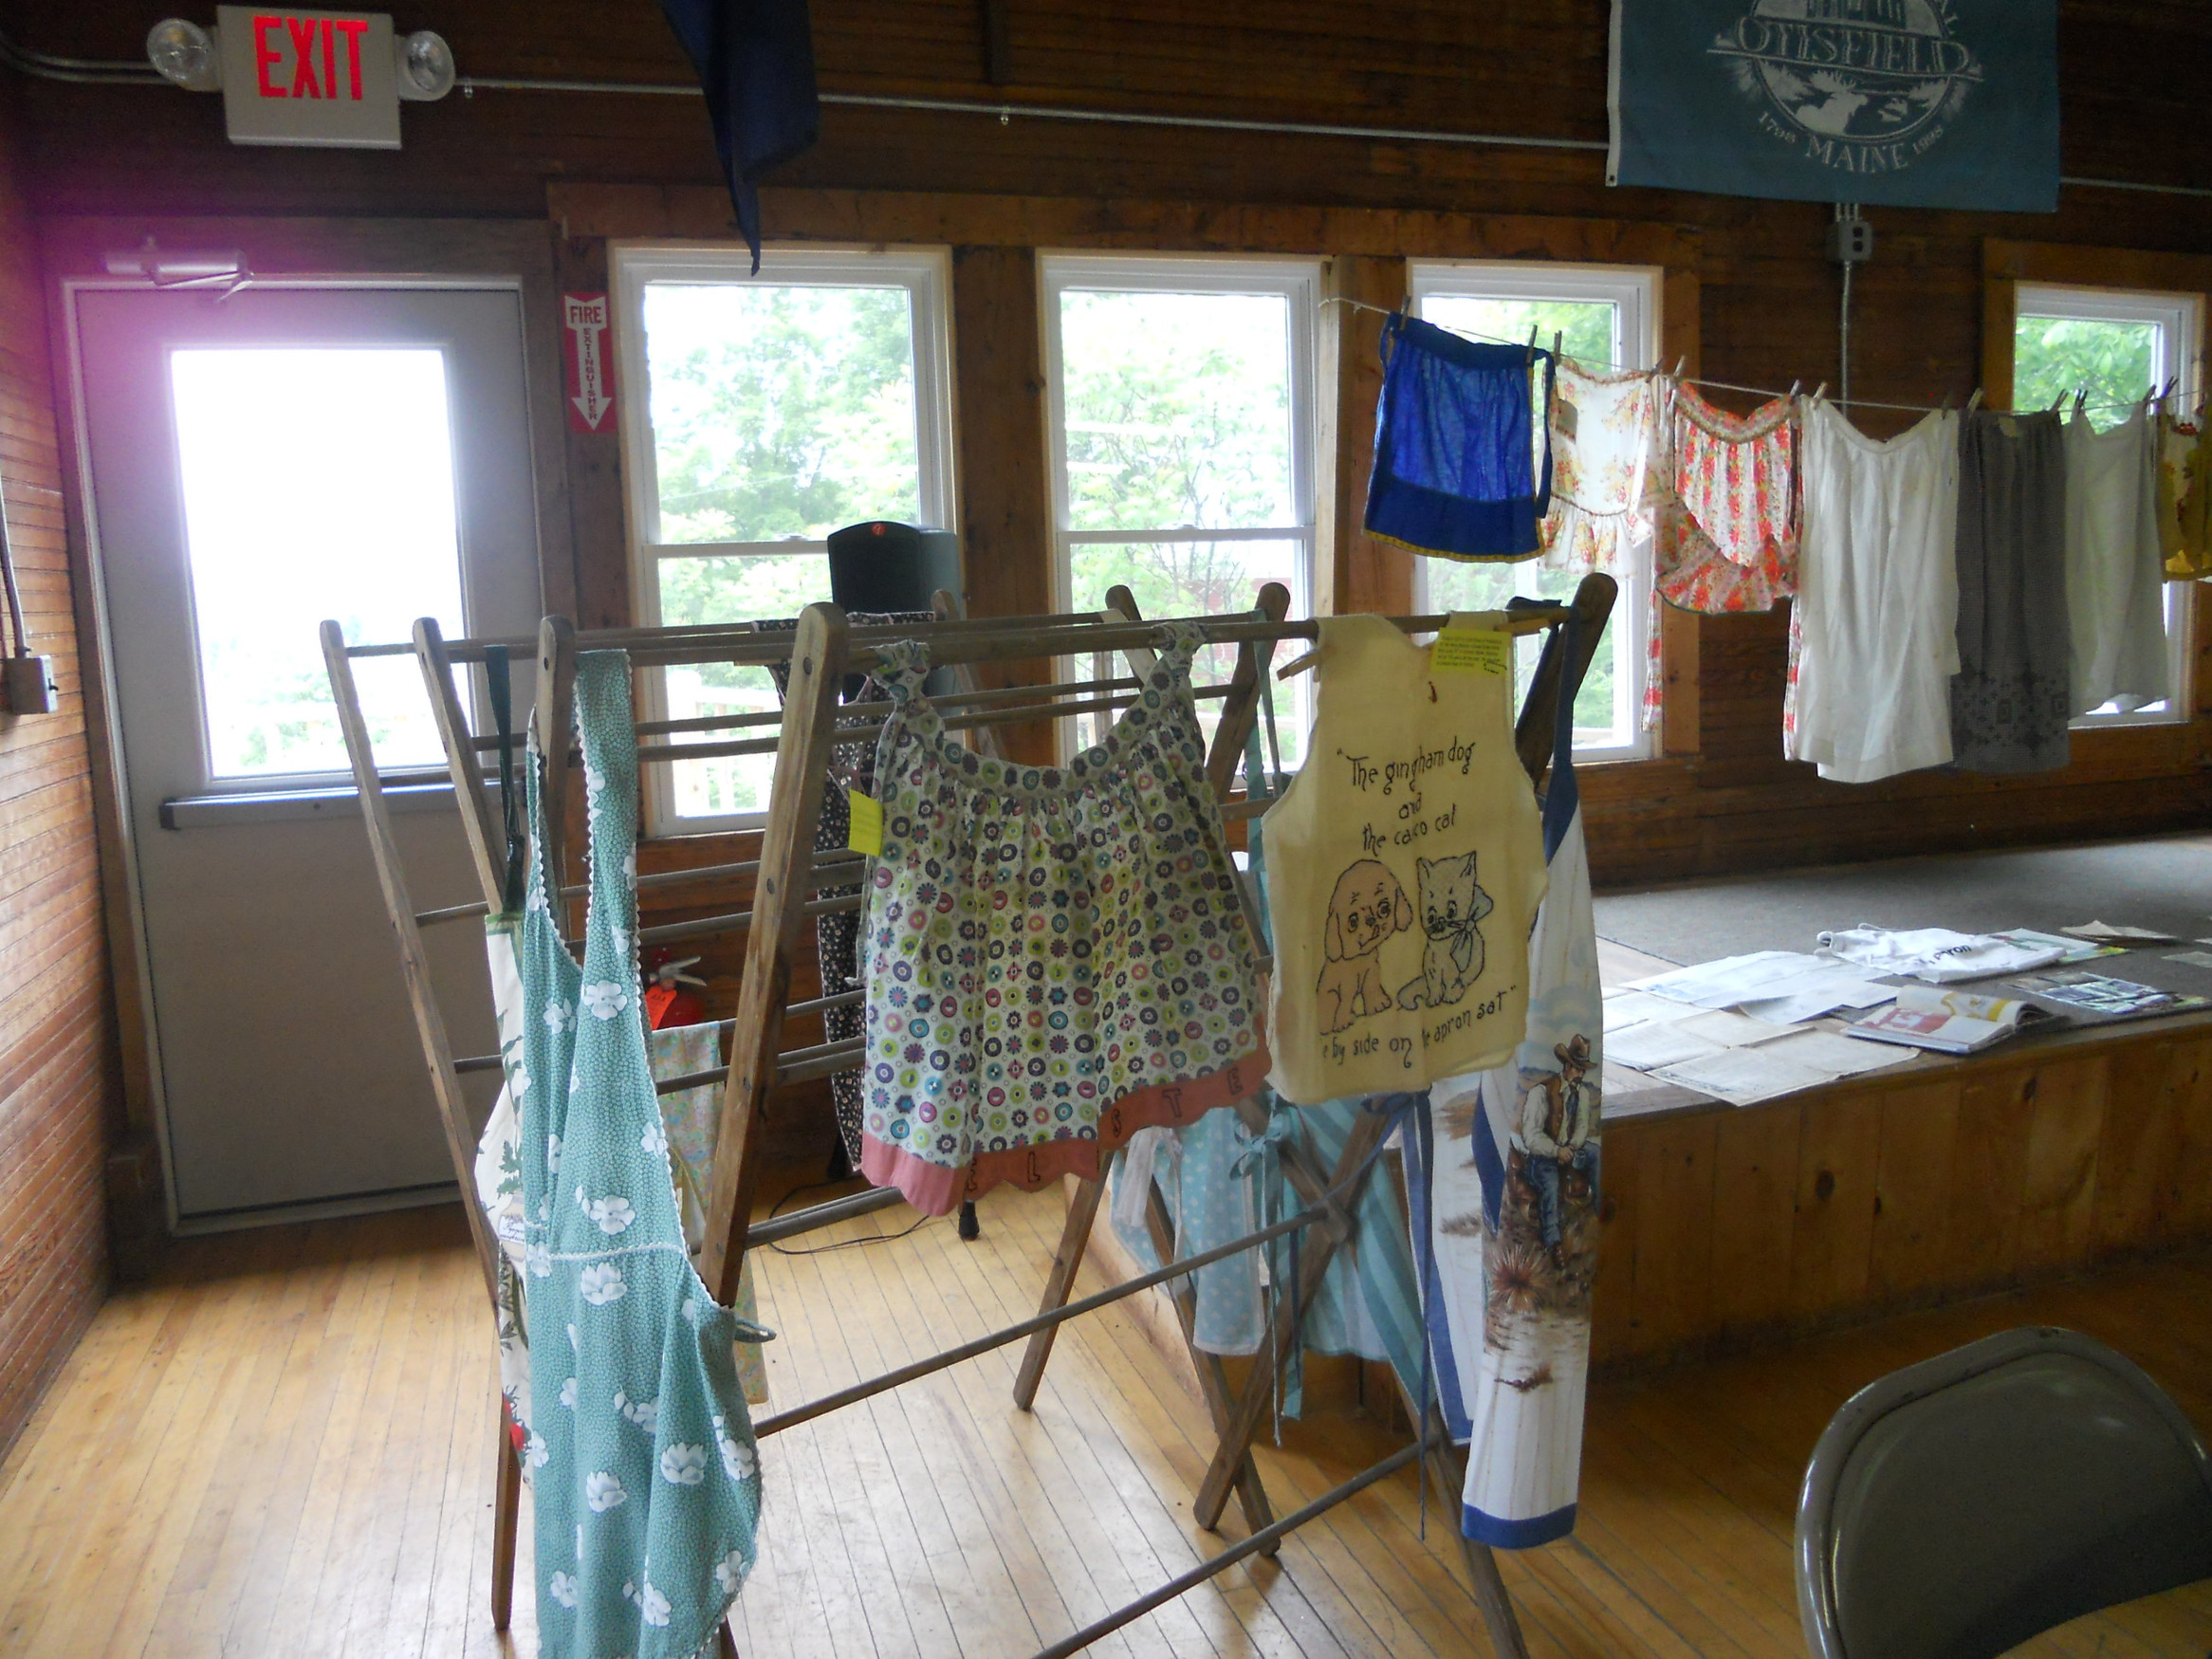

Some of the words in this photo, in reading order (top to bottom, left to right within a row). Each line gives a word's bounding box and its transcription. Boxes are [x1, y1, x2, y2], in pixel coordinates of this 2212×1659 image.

[253, 15, 368, 100] EXIT
[1737, 17, 1968, 73] OTISFIELD
[1805, 136, 1909, 174] MAINE
[570, 305, 602, 323] FIRE
[583, 327, 598, 419] EXTINGUISHER
[1447, 735, 1476, 775] dog
[1362, 822, 1386, 857] the
[1353, 1032, 1379, 1056] side
[1389, 1037, 1412, 1068] on
[1433, 1010, 1471, 1043] apron
